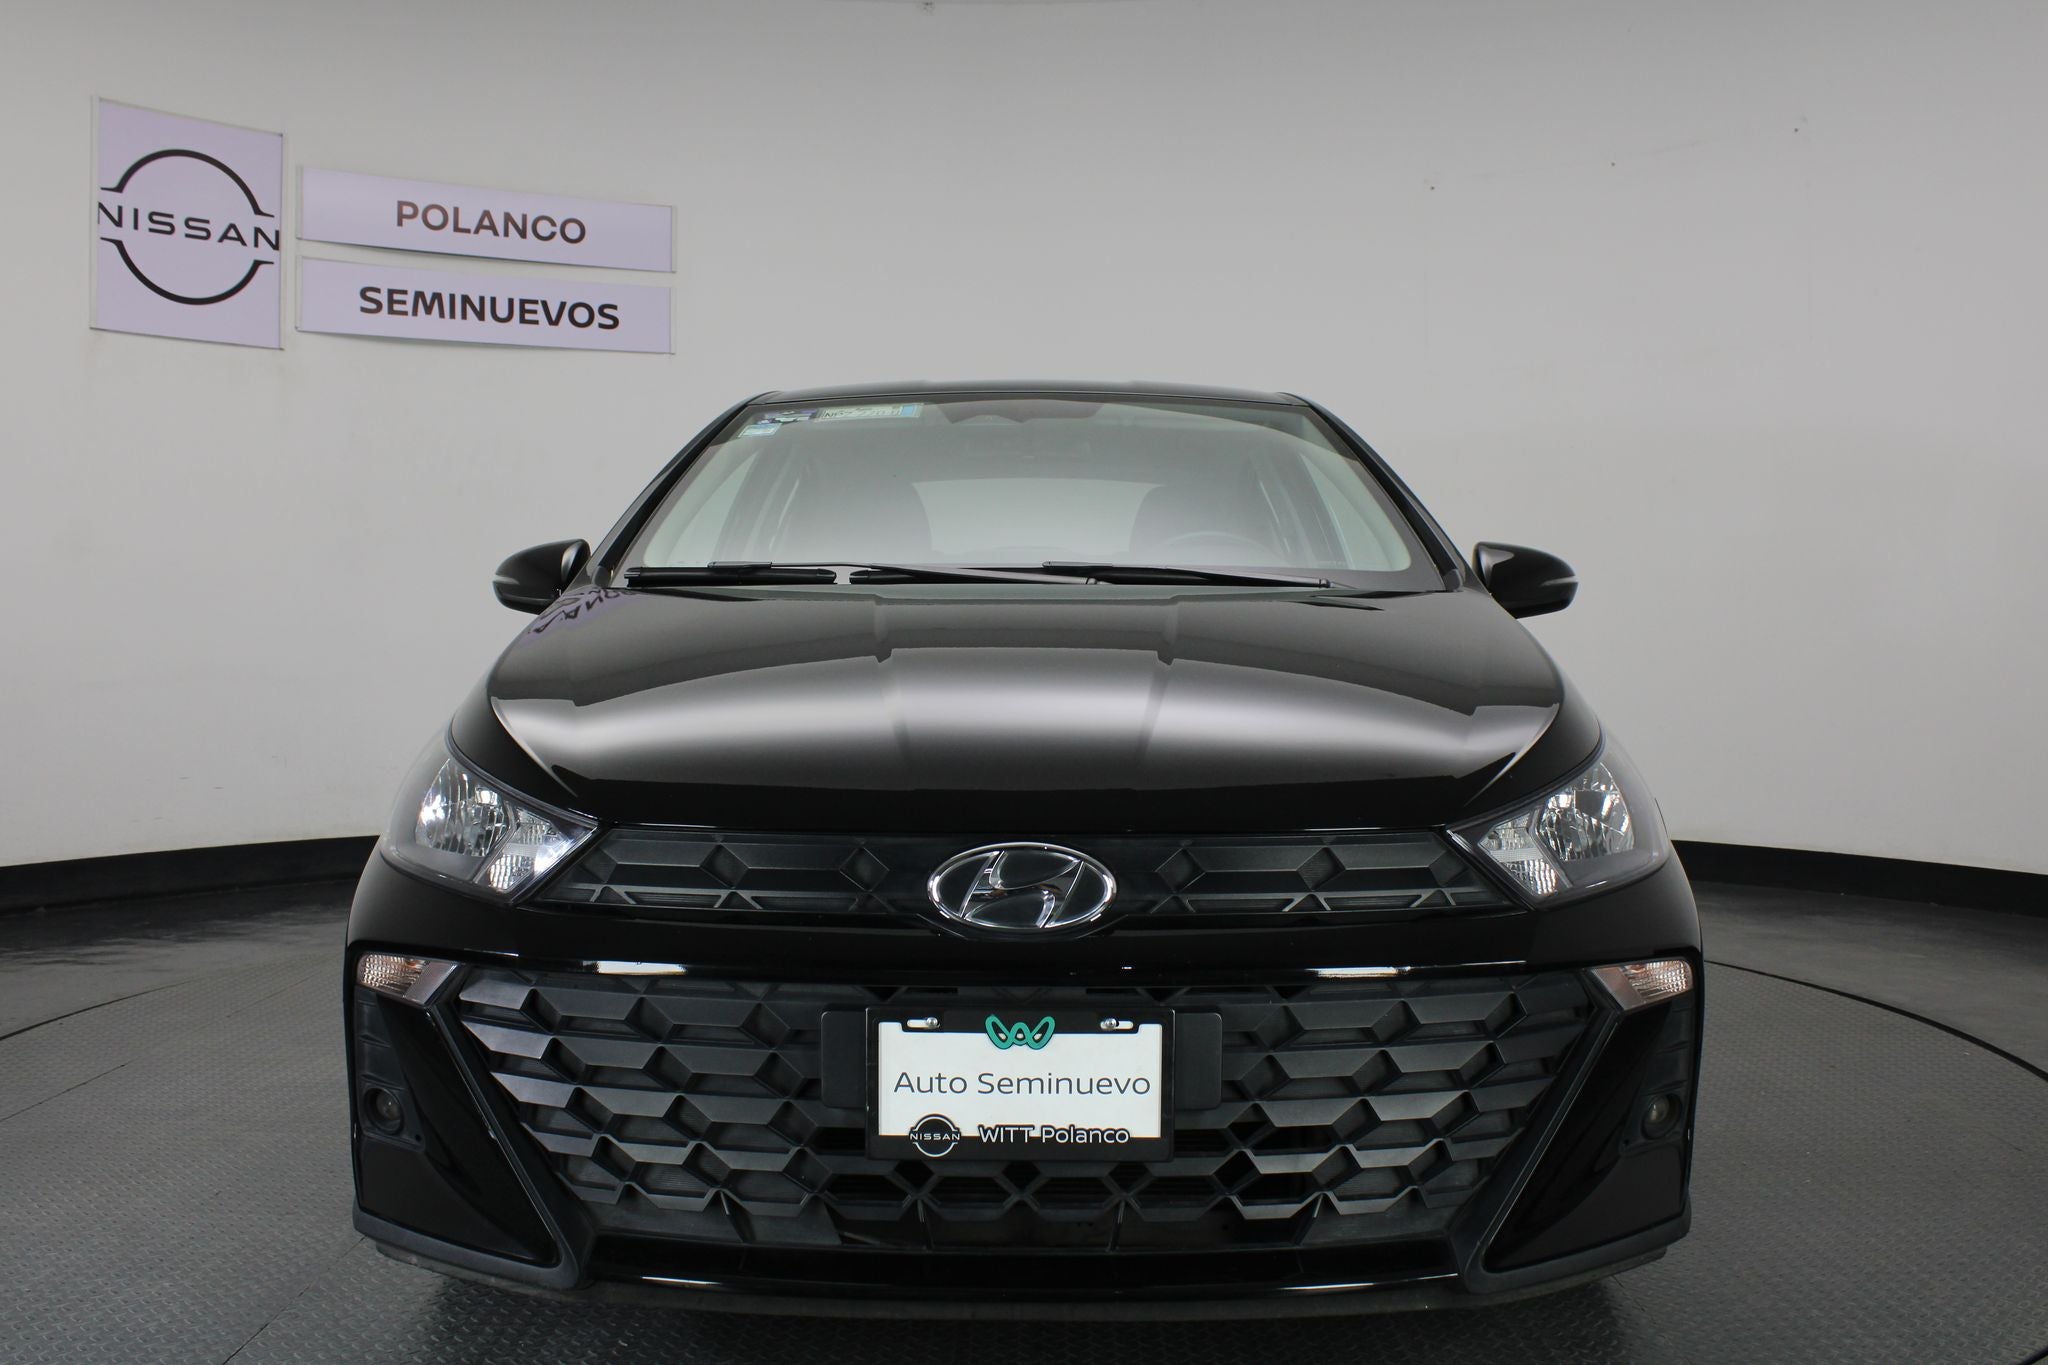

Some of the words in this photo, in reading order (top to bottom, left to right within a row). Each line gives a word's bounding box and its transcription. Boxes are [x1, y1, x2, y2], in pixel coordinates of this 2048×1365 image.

[97, 201, 280, 251] NISSAN
[396, 200, 587, 244] POLANCO
[359, 286, 620, 329] SEMINUEVOS
[893, 1072, 968, 1094] Auto
[977, 1072, 1151, 1095] Seminuevo
[909, 1132, 961, 1142] NISSAN
[978, 1125, 1035, 1144] WITT
[1041, 1125, 1130, 1144] Polanco
